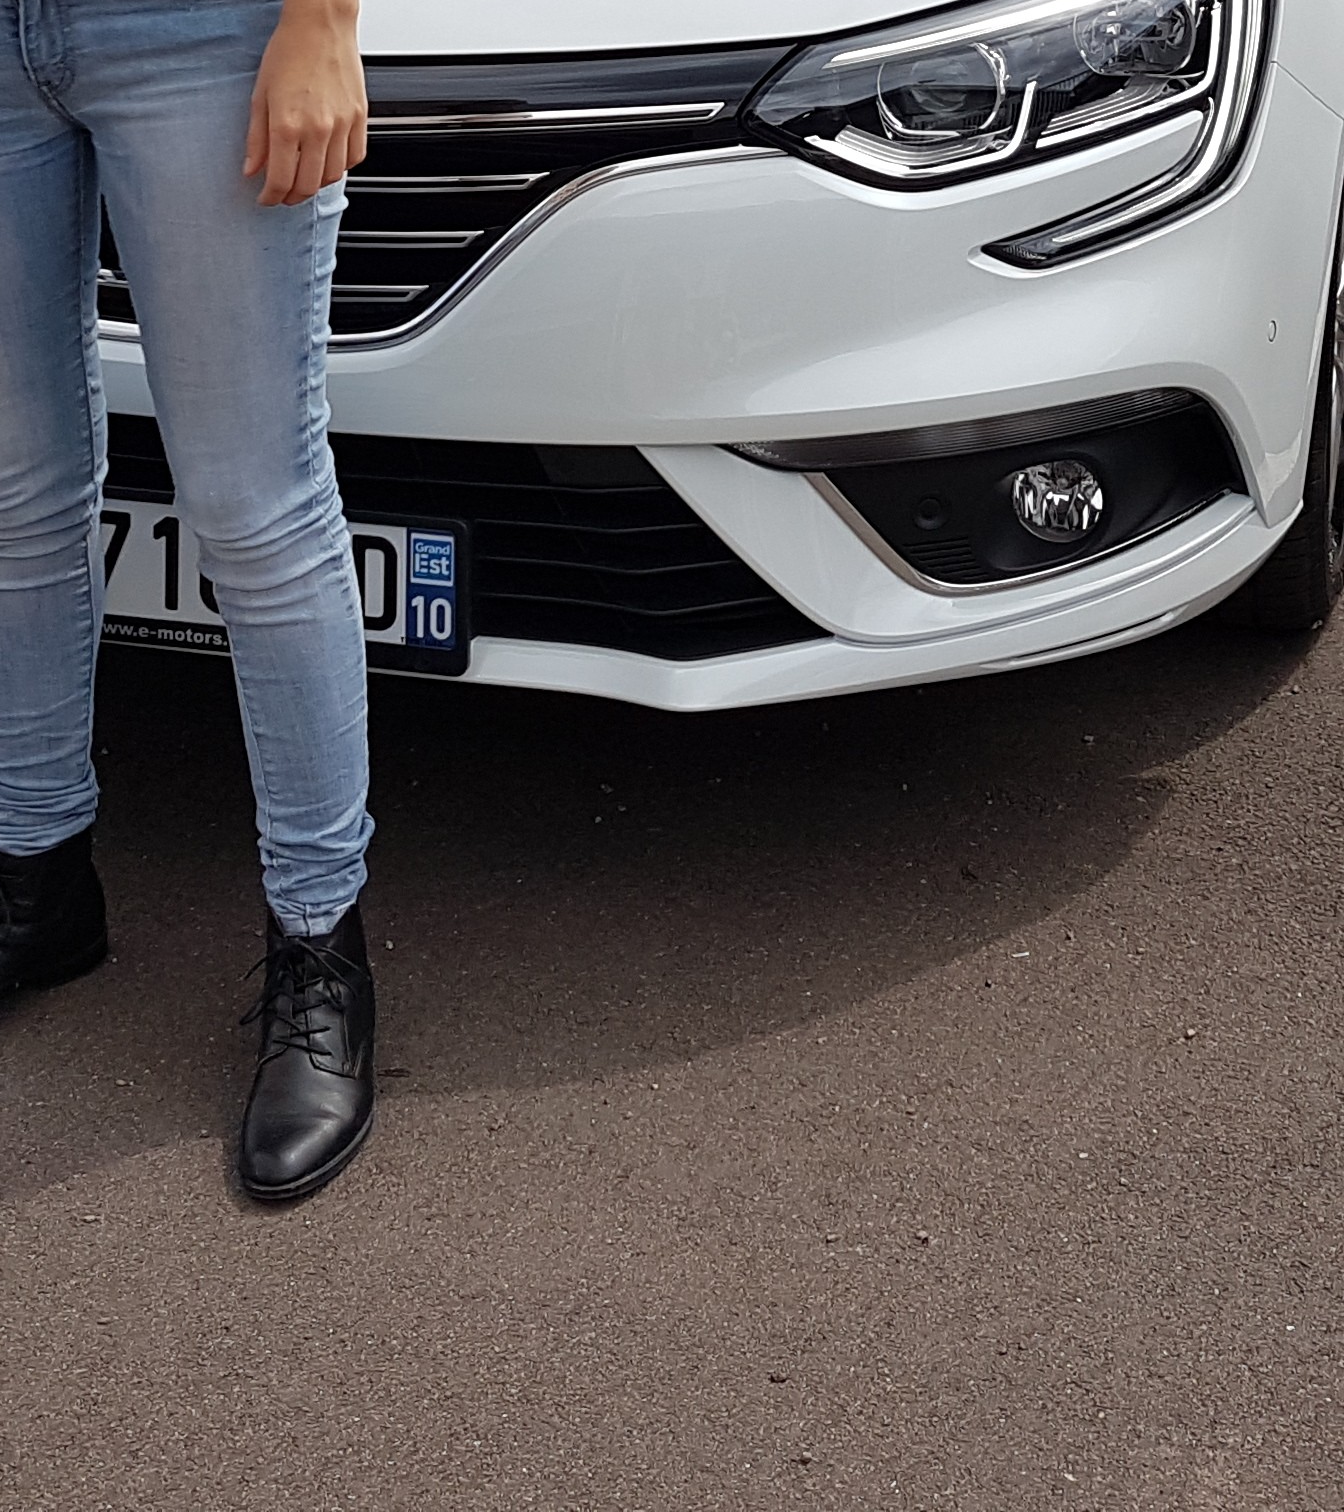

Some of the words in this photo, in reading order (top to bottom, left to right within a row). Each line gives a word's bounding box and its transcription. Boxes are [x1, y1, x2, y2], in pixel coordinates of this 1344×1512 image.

[415, 542, 451, 555] Grand
[414, 553, 450, 576] Est
[411, 595, 452, 641] 10
